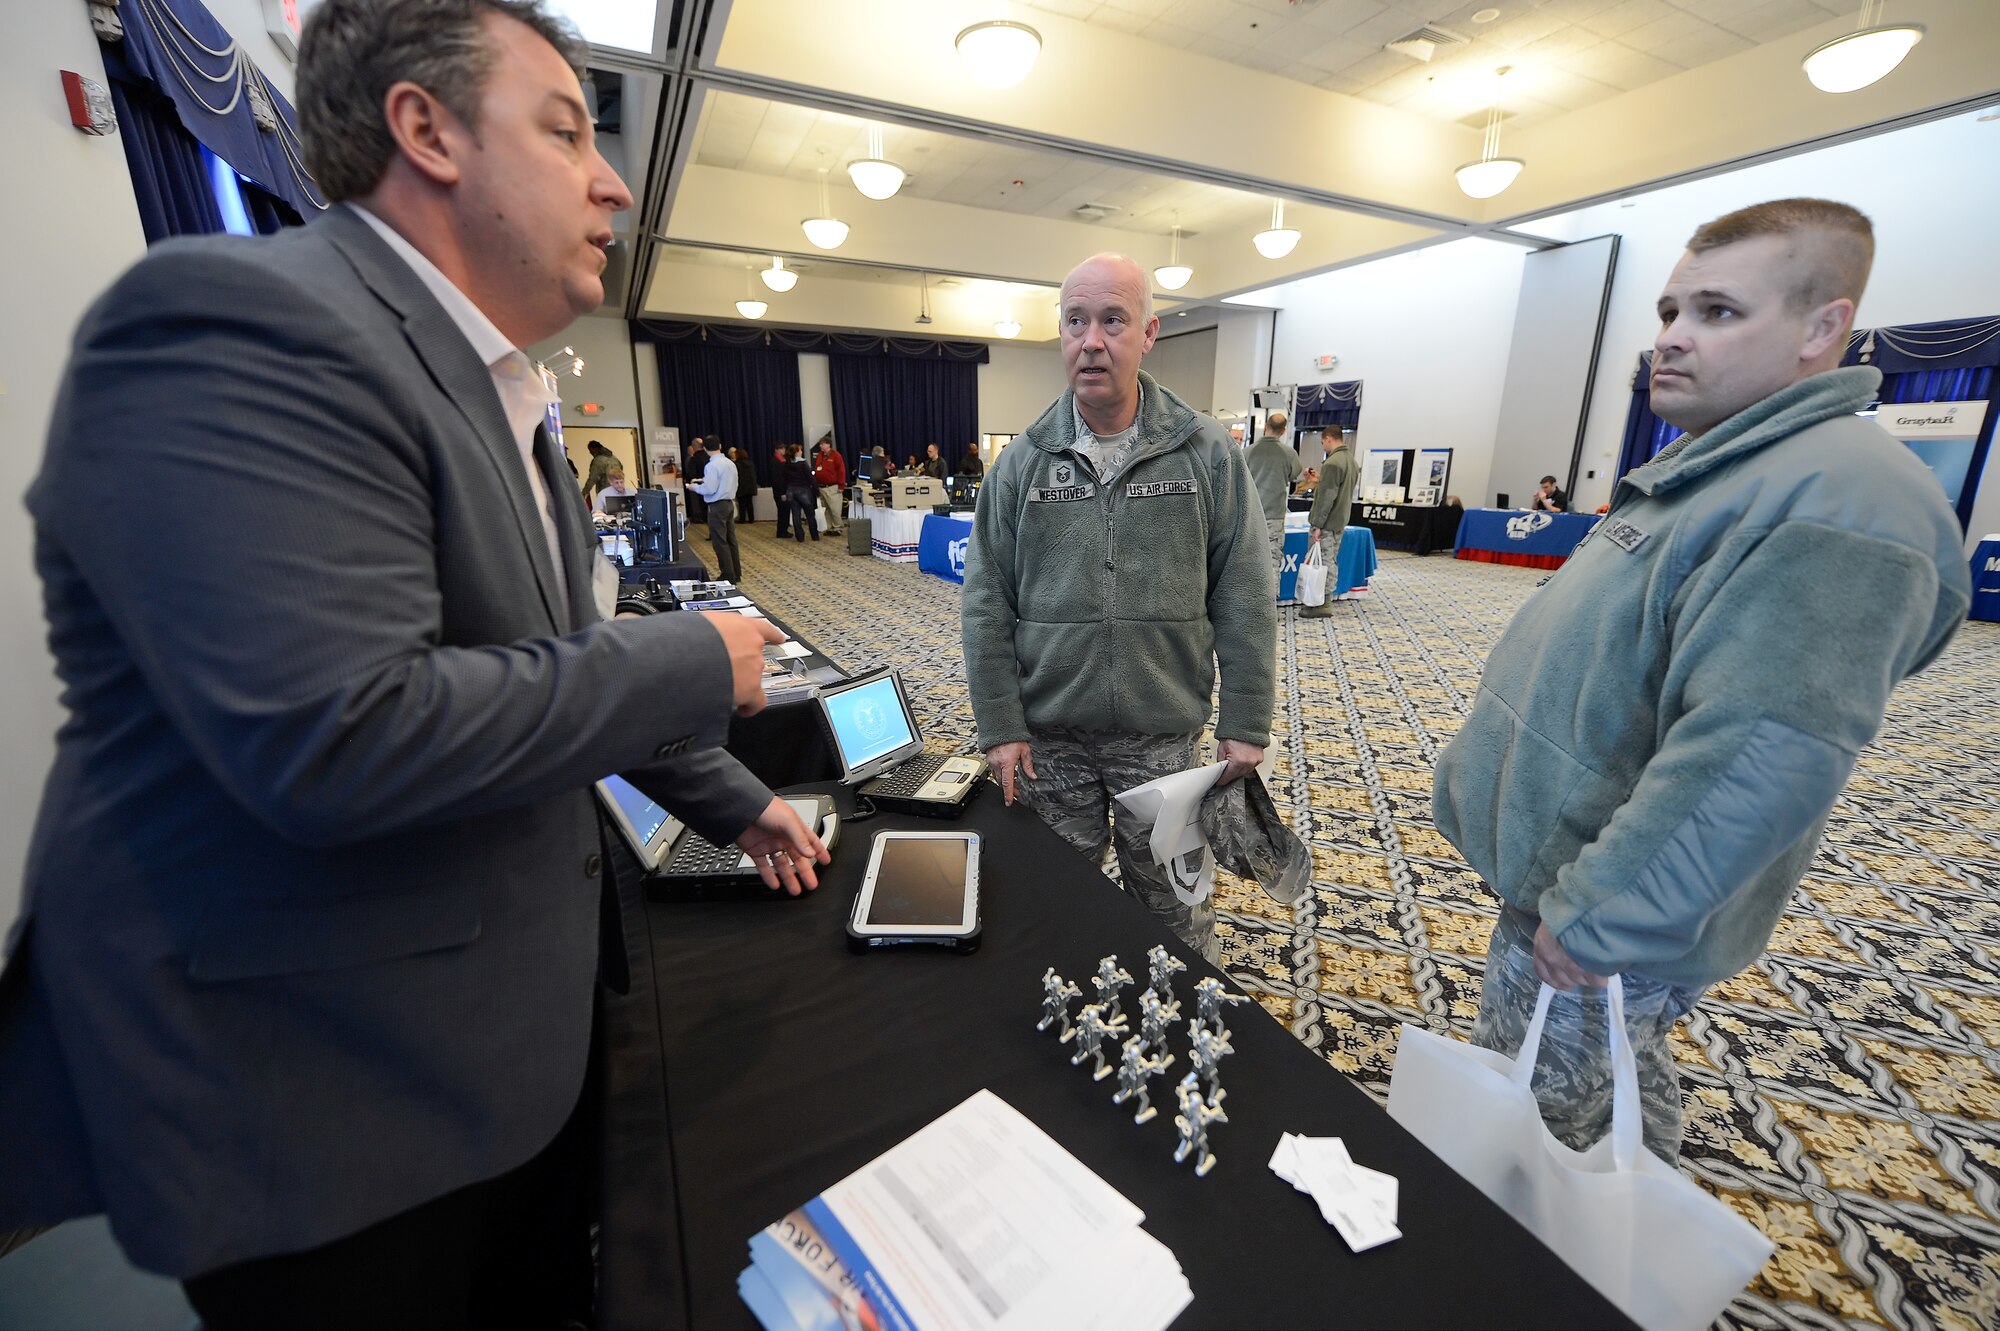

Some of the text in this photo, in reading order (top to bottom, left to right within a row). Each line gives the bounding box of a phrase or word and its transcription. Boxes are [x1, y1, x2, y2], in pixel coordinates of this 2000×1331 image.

[1038, 486, 1086, 501] WESTOVER
[1146, 483, 1161, 496] AIR
[1163, 481, 1193, 493] FORCE
[1362, 505, 1398, 520] EATON
